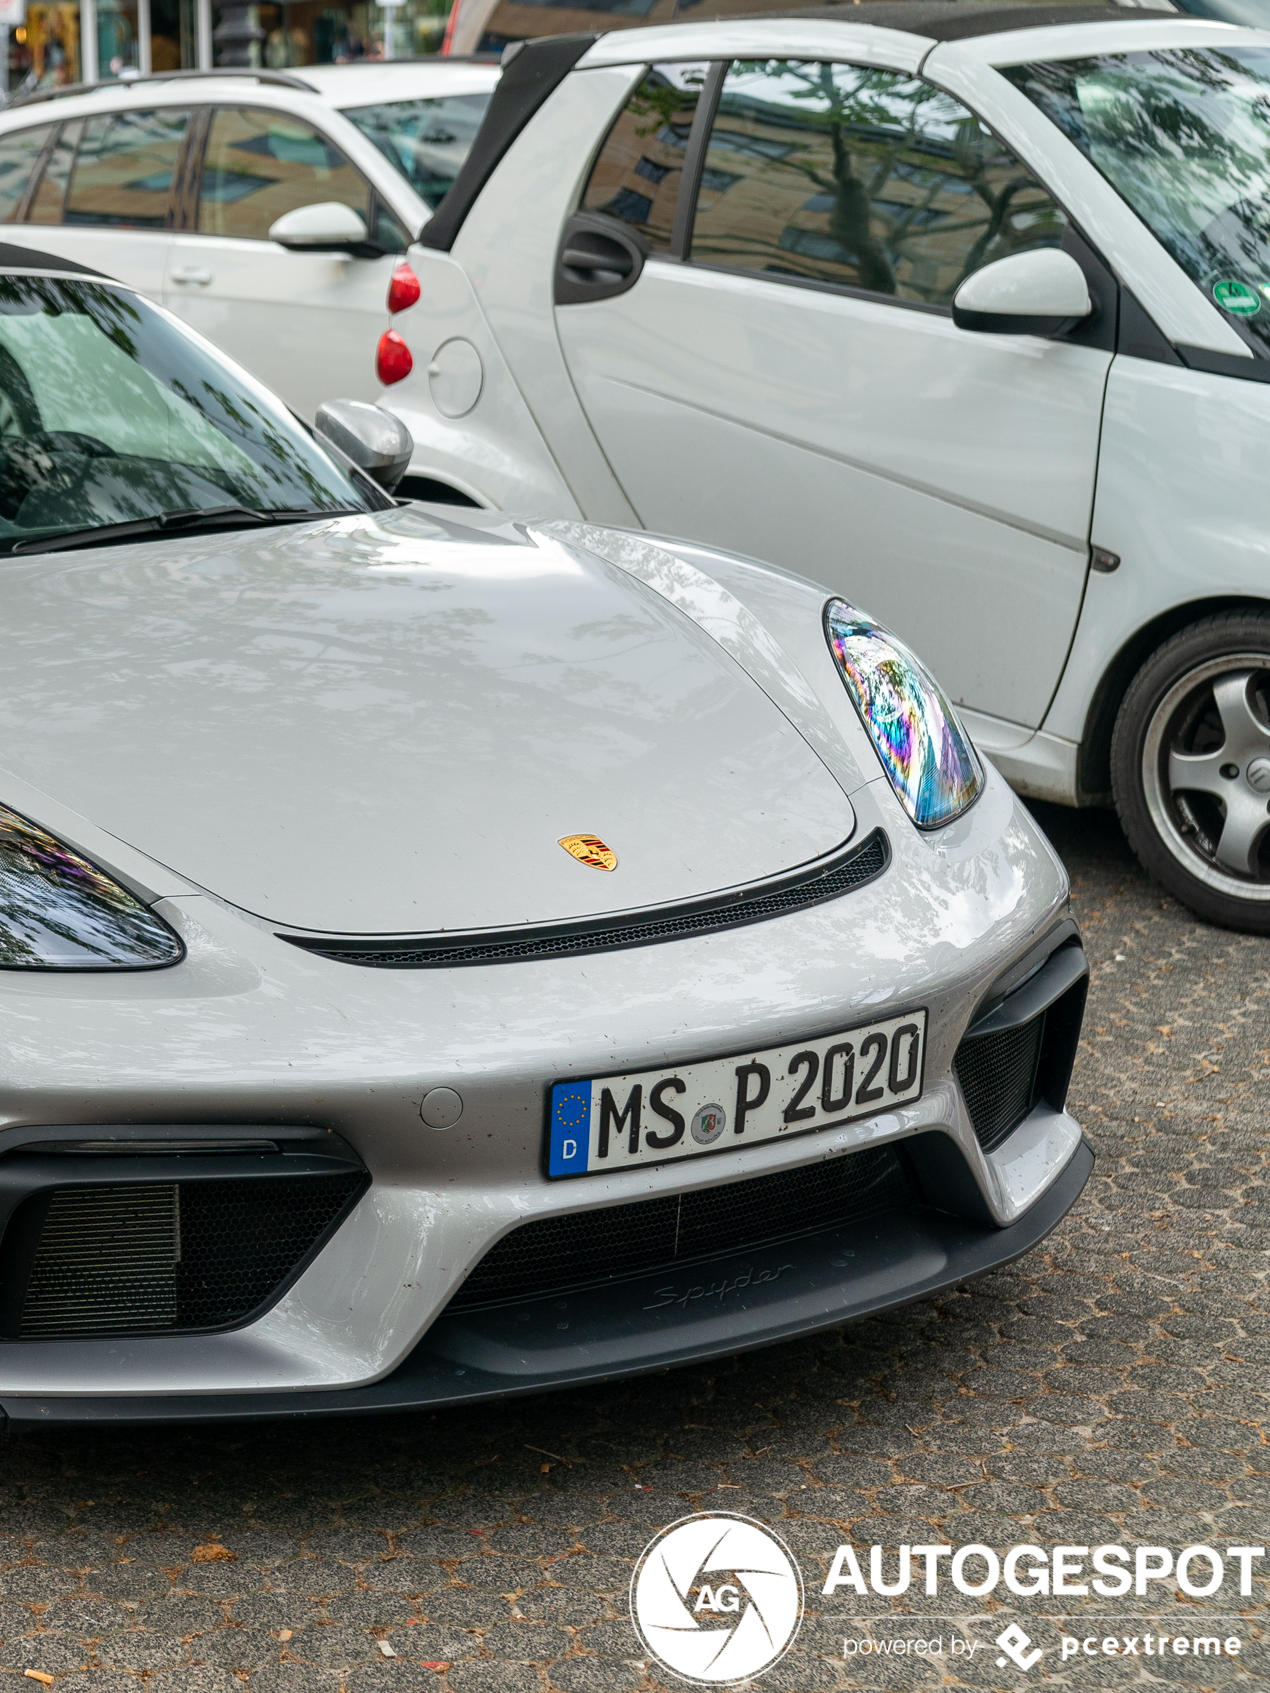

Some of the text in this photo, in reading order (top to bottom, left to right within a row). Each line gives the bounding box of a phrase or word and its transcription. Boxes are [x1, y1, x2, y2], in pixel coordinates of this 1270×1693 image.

[598, 1023, 920, 1158] MS P 2020
[562, 1139, 577, 1159] D
[642, 1264, 797, 1309] Spyder
